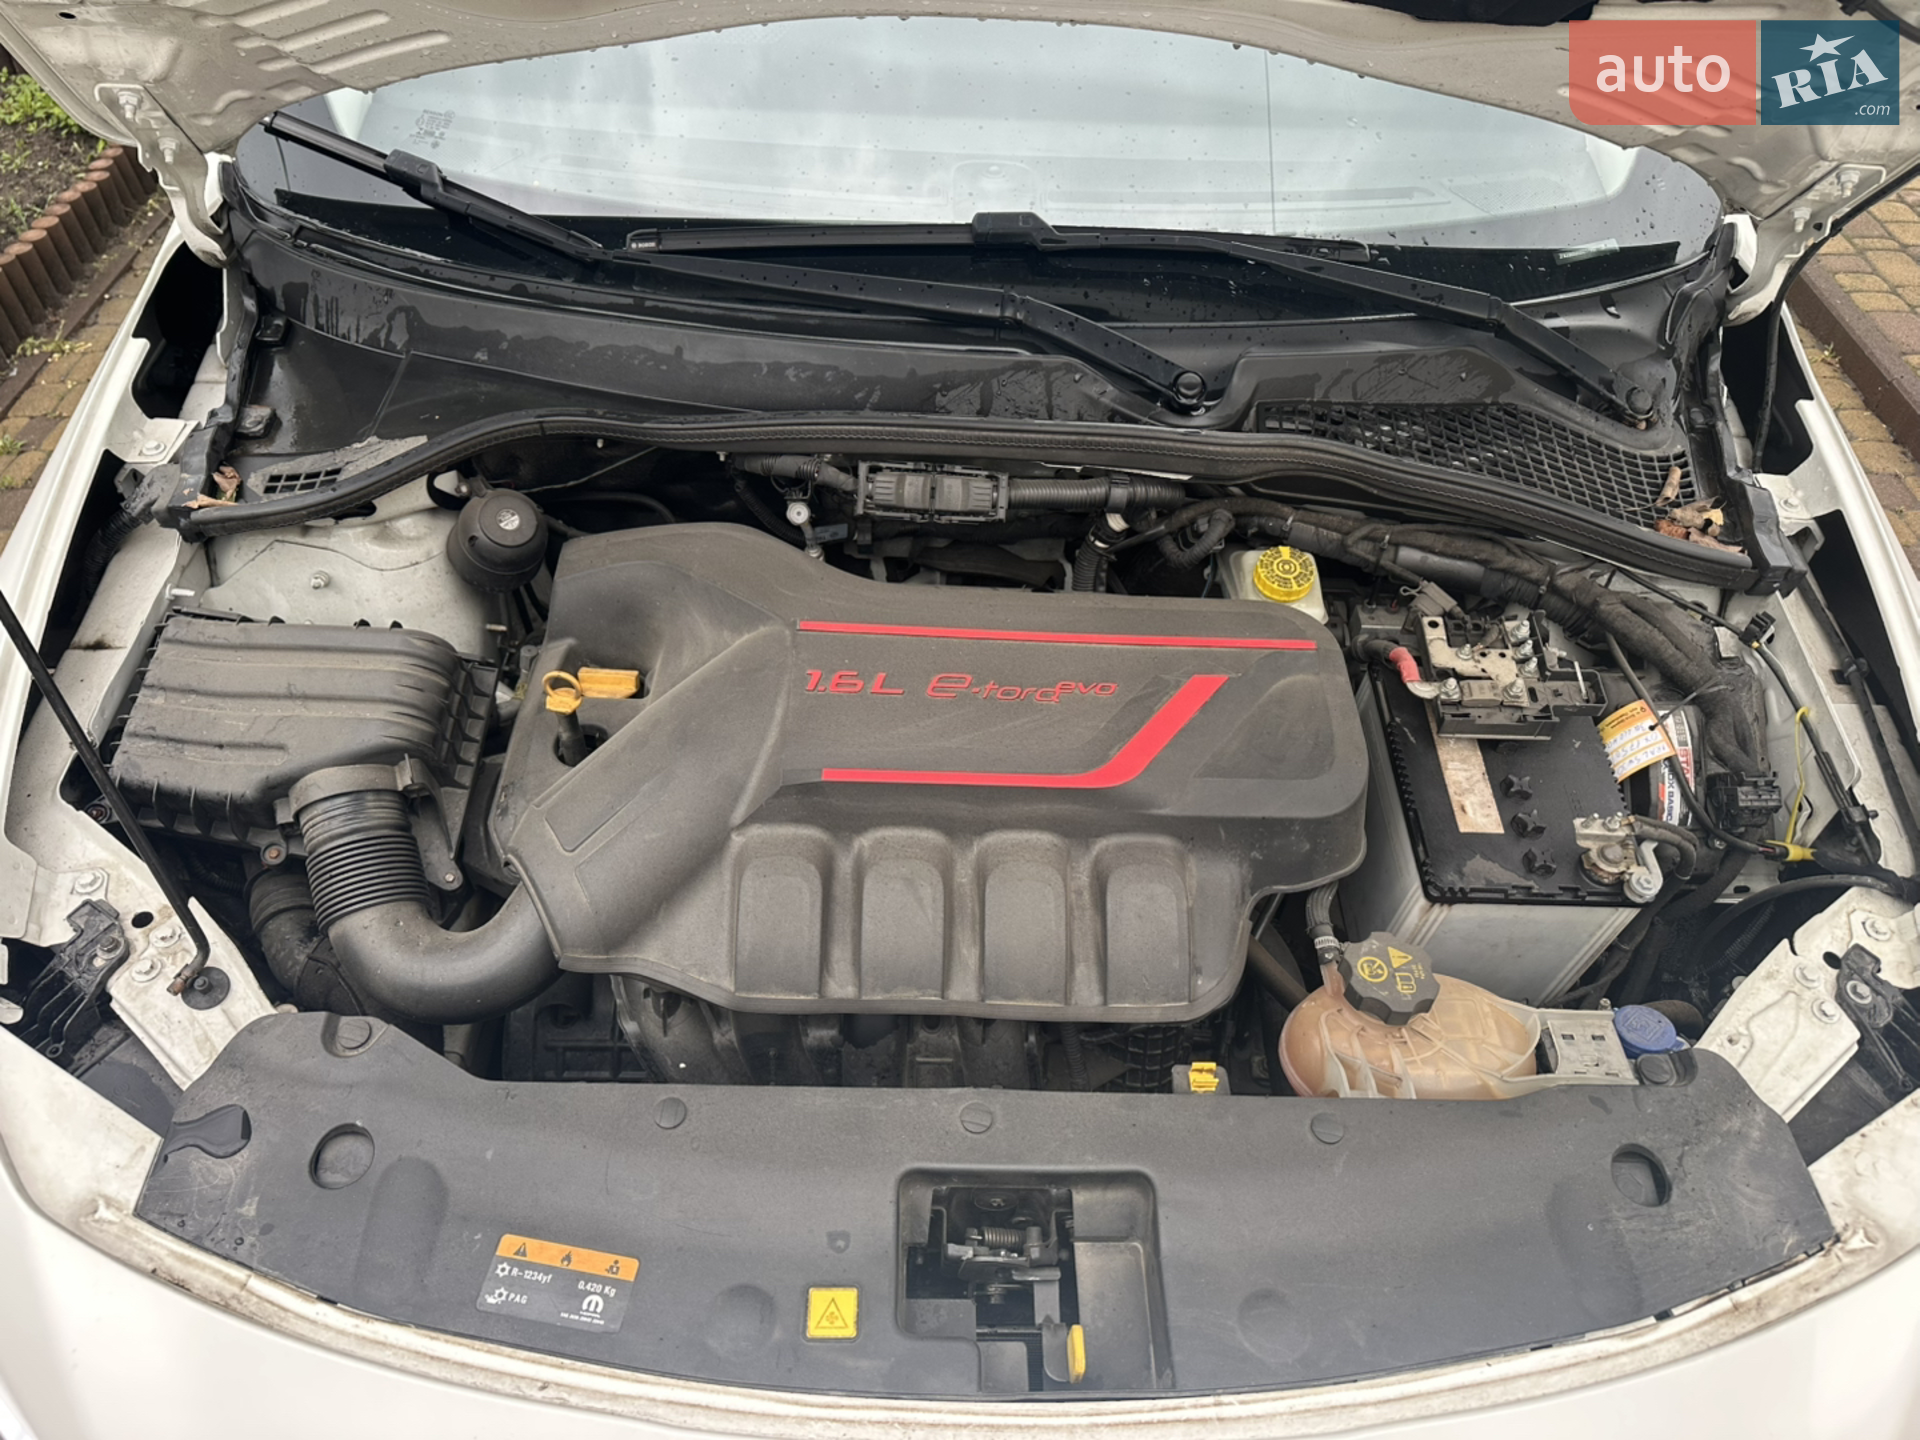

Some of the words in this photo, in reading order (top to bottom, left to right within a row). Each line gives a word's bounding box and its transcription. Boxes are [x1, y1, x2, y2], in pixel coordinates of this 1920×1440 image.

[511, 1267, 552, 1284] R-1234yf
[603, 1284, 617, 1298] Kg
[507, 1292, 529, 1305] PAG
